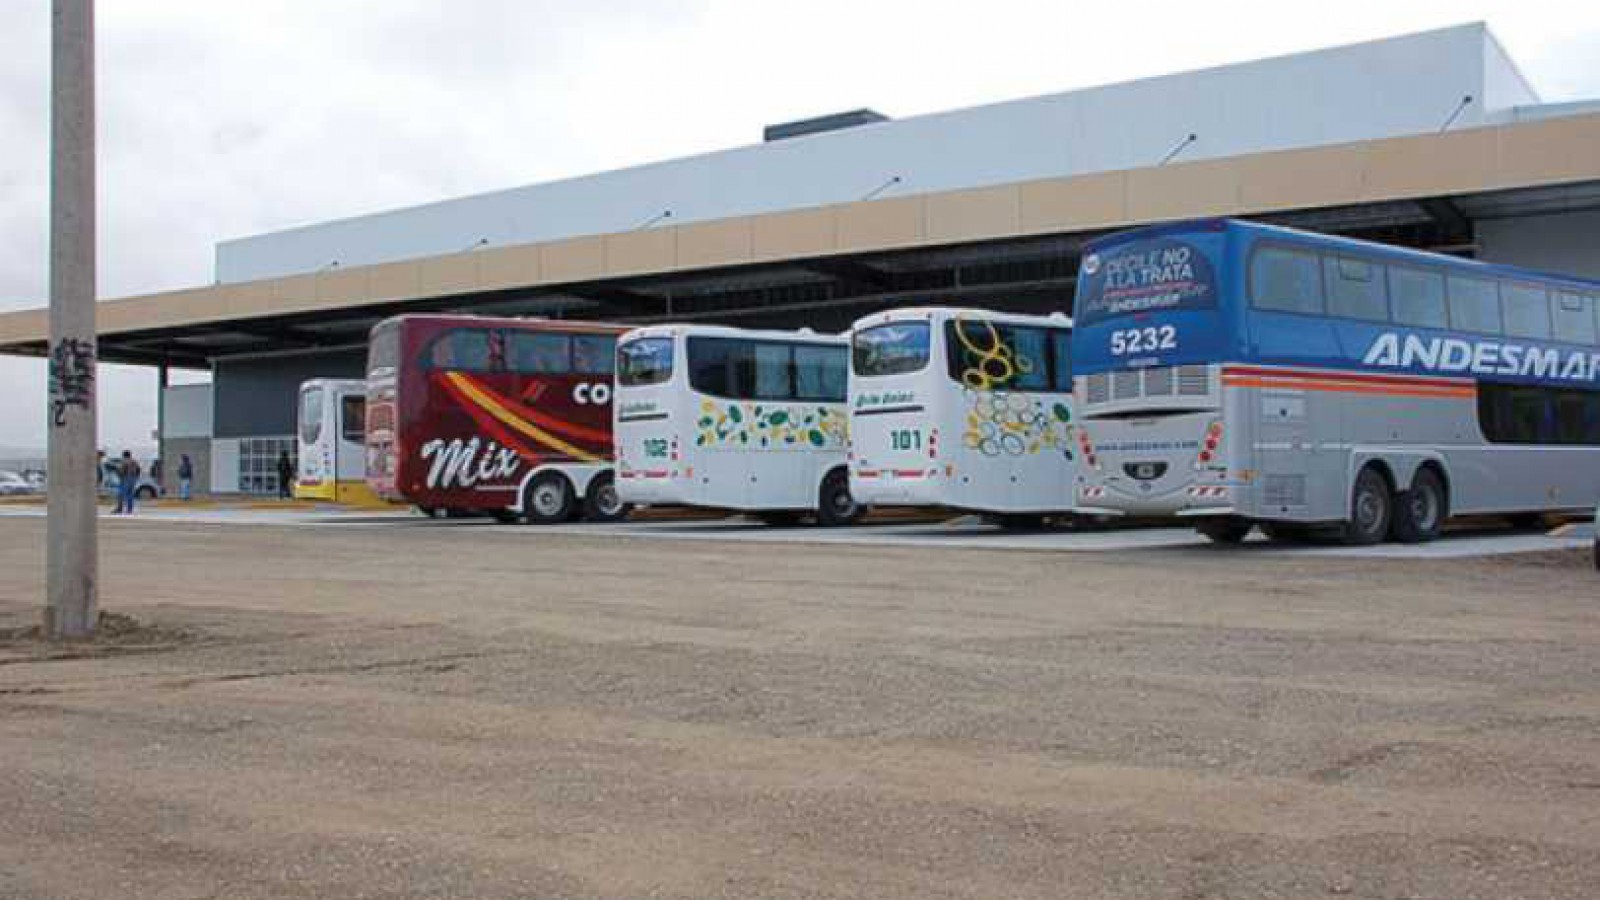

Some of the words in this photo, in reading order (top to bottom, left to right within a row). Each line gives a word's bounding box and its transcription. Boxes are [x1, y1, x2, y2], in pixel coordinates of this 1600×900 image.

[1162, 247, 1191, 265] NO
[1116, 270, 1137, 286] LA
[1142, 263, 1194, 283] TRATA
[1110, 325, 1177, 356] 5232
[643, 439, 668, 457] 102
[890, 429, 921, 451] 101
[421, 436, 521, 489] Mix
